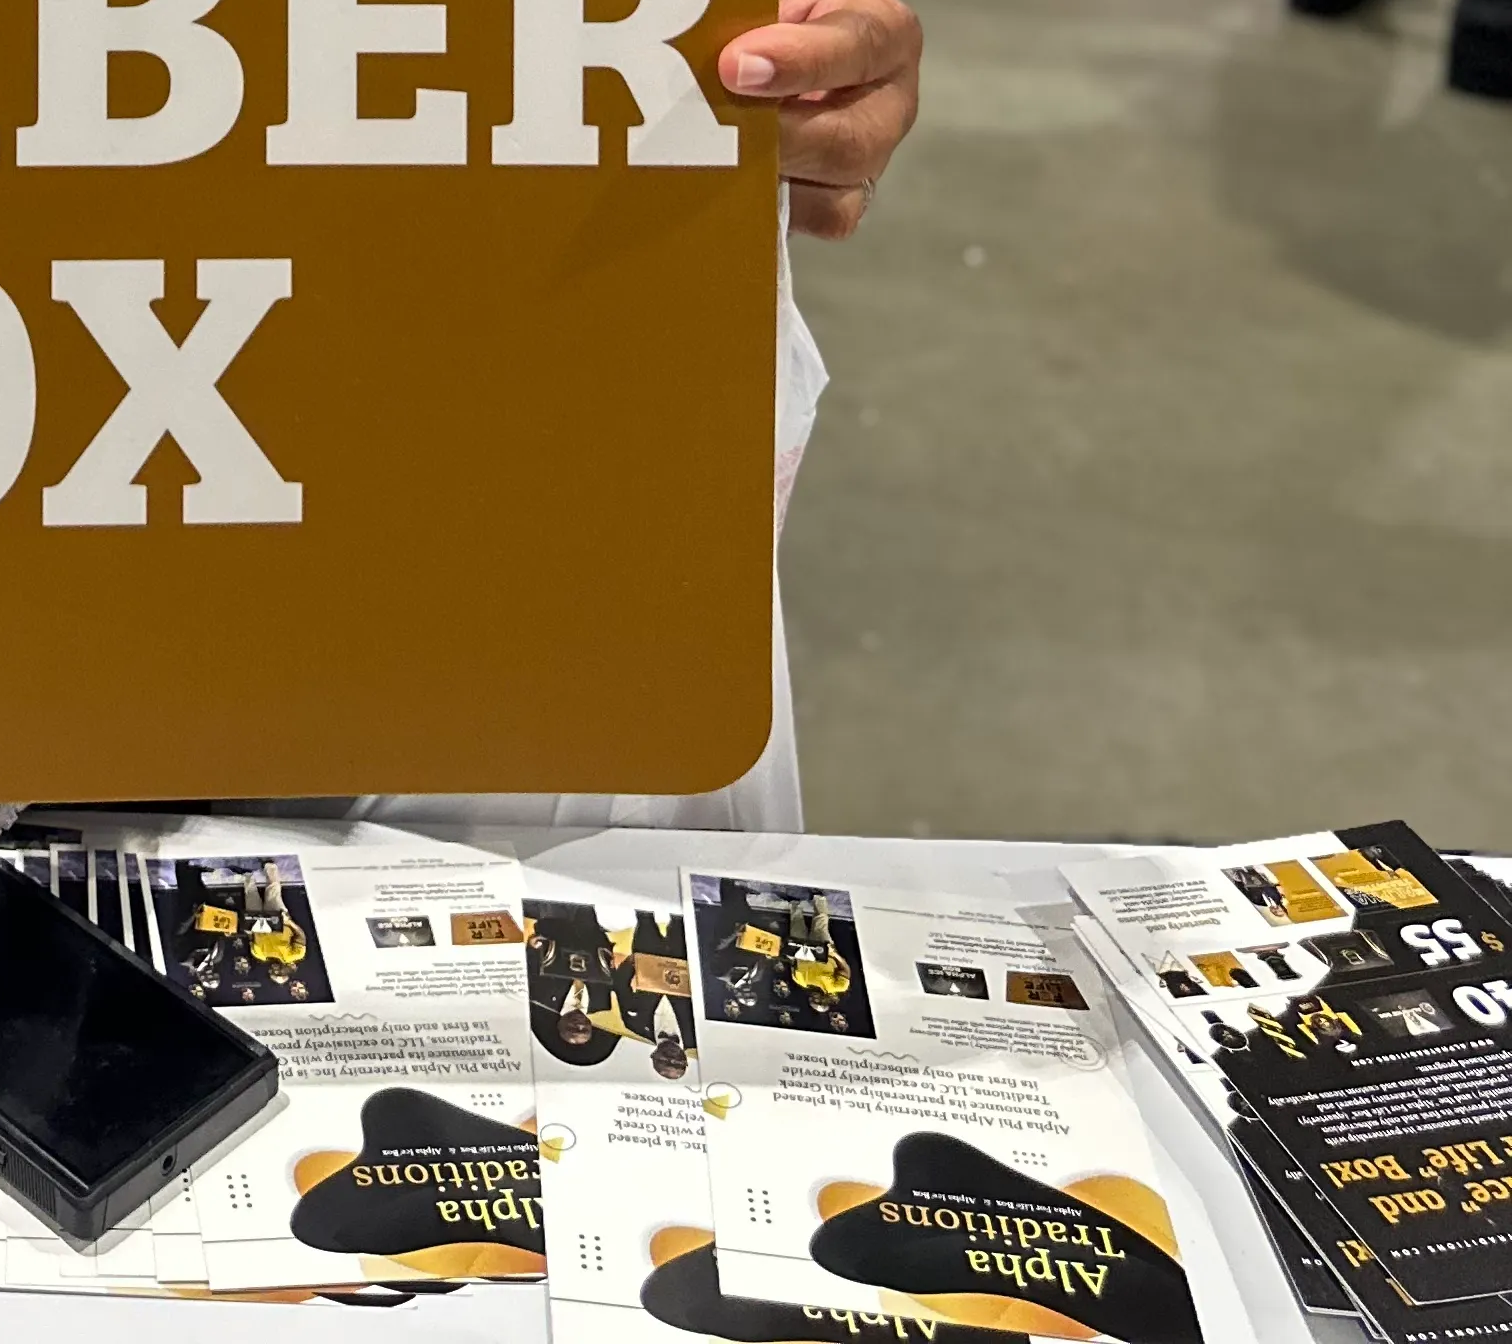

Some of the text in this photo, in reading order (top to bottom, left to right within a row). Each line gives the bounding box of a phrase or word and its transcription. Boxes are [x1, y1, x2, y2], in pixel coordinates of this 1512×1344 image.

[1399, 918, 1504, 967] $ 55
[295, 1021, 489, 1036] its first and only subscription
[304, 1039, 378, 1050] exclusively
[381, 1038, 394, 1047] to
[396, 1038, 425, 1048] LLC
[324, 1049, 404, 1063] partnership
[408, 1050, 425, 1061] its
[427, 1049, 493, 1058] announce
[496, 1049, 511, 1057] to
[291, 1055, 322, 1065] with
[481, 1059, 521, 1072] Alpha
[297, 1069, 307, 1079] is
[340, 1065, 408, 1077] Fraternity
[411, 1062, 451, 1076] Alpha
[455, 1063, 479, 1073] Phi
[781, 1066, 837, 1079] provide
[784, 1052, 1039, 1091] its first and only subscription boxes.
[839, 1071, 917, 1088] exclusively
[921, 1082, 936, 1092] to
[939, 1084, 968, 1096] LLC
[777, 1079, 1059, 1120] to announce its partnership with Greek
[617, 1105, 673, 1119] provide
[773, 1092, 1069, 1135] Alpha Phi Alpha Fraternity Inc. is pleased
[613, 1119, 657, 1133] Greek
[660, 1125, 693, 1136] with
[607, 1133, 661, 1148] pleased
[664, 1140, 676, 1151] is
[415, 1146, 442, 1155] Alpha
[352, 1158, 540, 1193] raditions
[1319, 1155, 1411, 1189] Box!
[947, 1193, 976, 1206] Alpha
[435, 1188, 544, 1231] lpha
[1053, 1205, 1082, 1218] Alpha
[1368, 1189, 1446, 1225] and
[878, 1201, 1126, 1259] Traditions
[964, 1247, 1109, 1298] Alpha
